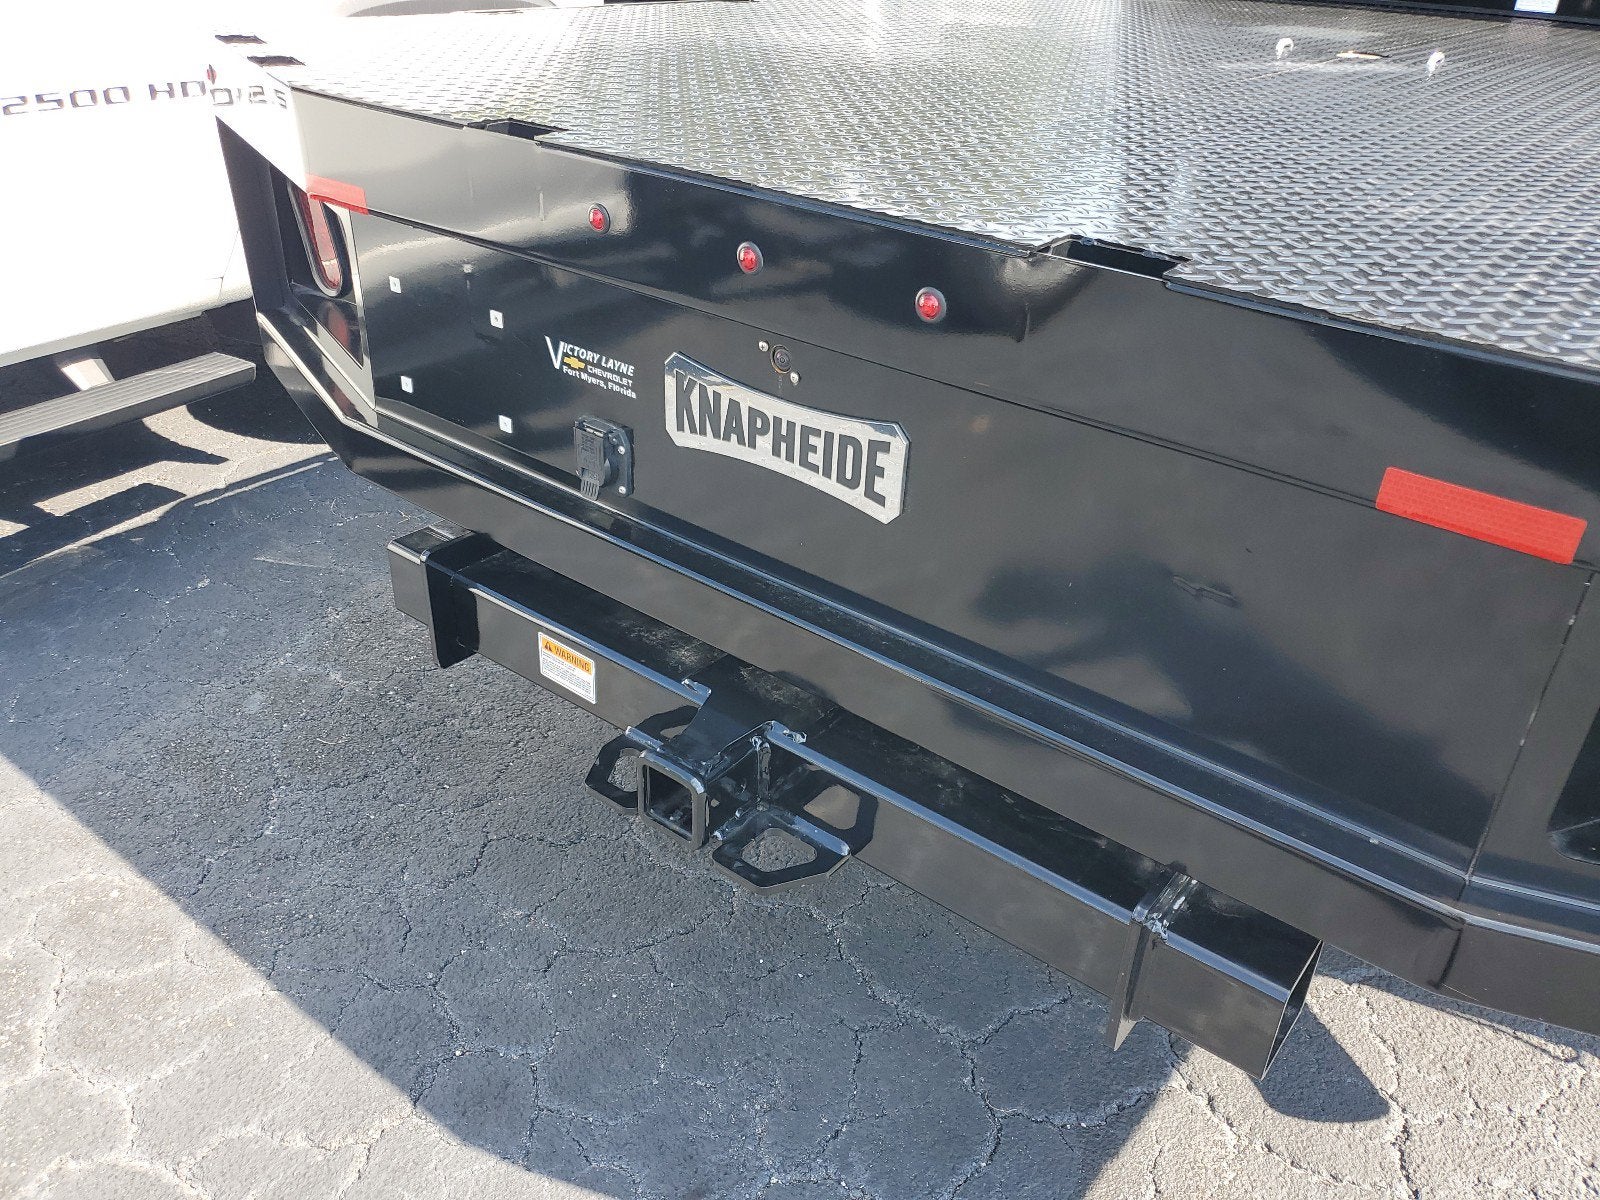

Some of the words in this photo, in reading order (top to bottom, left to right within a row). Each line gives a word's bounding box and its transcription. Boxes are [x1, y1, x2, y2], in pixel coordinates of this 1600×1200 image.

[1, 86, 131, 115] 2500
[148, 81, 207, 100] HD
[544, 335, 600, 369] VICTORY
[601, 355, 635, 376] LAYNE
[562, 365, 580, 379] Fort
[607, 381, 637, 399] Florida
[587, 365, 633, 387] CHEVROLET
[674, 368, 891, 509] KNAPHEIDE
[554, 645, 590, 672] WARNING
